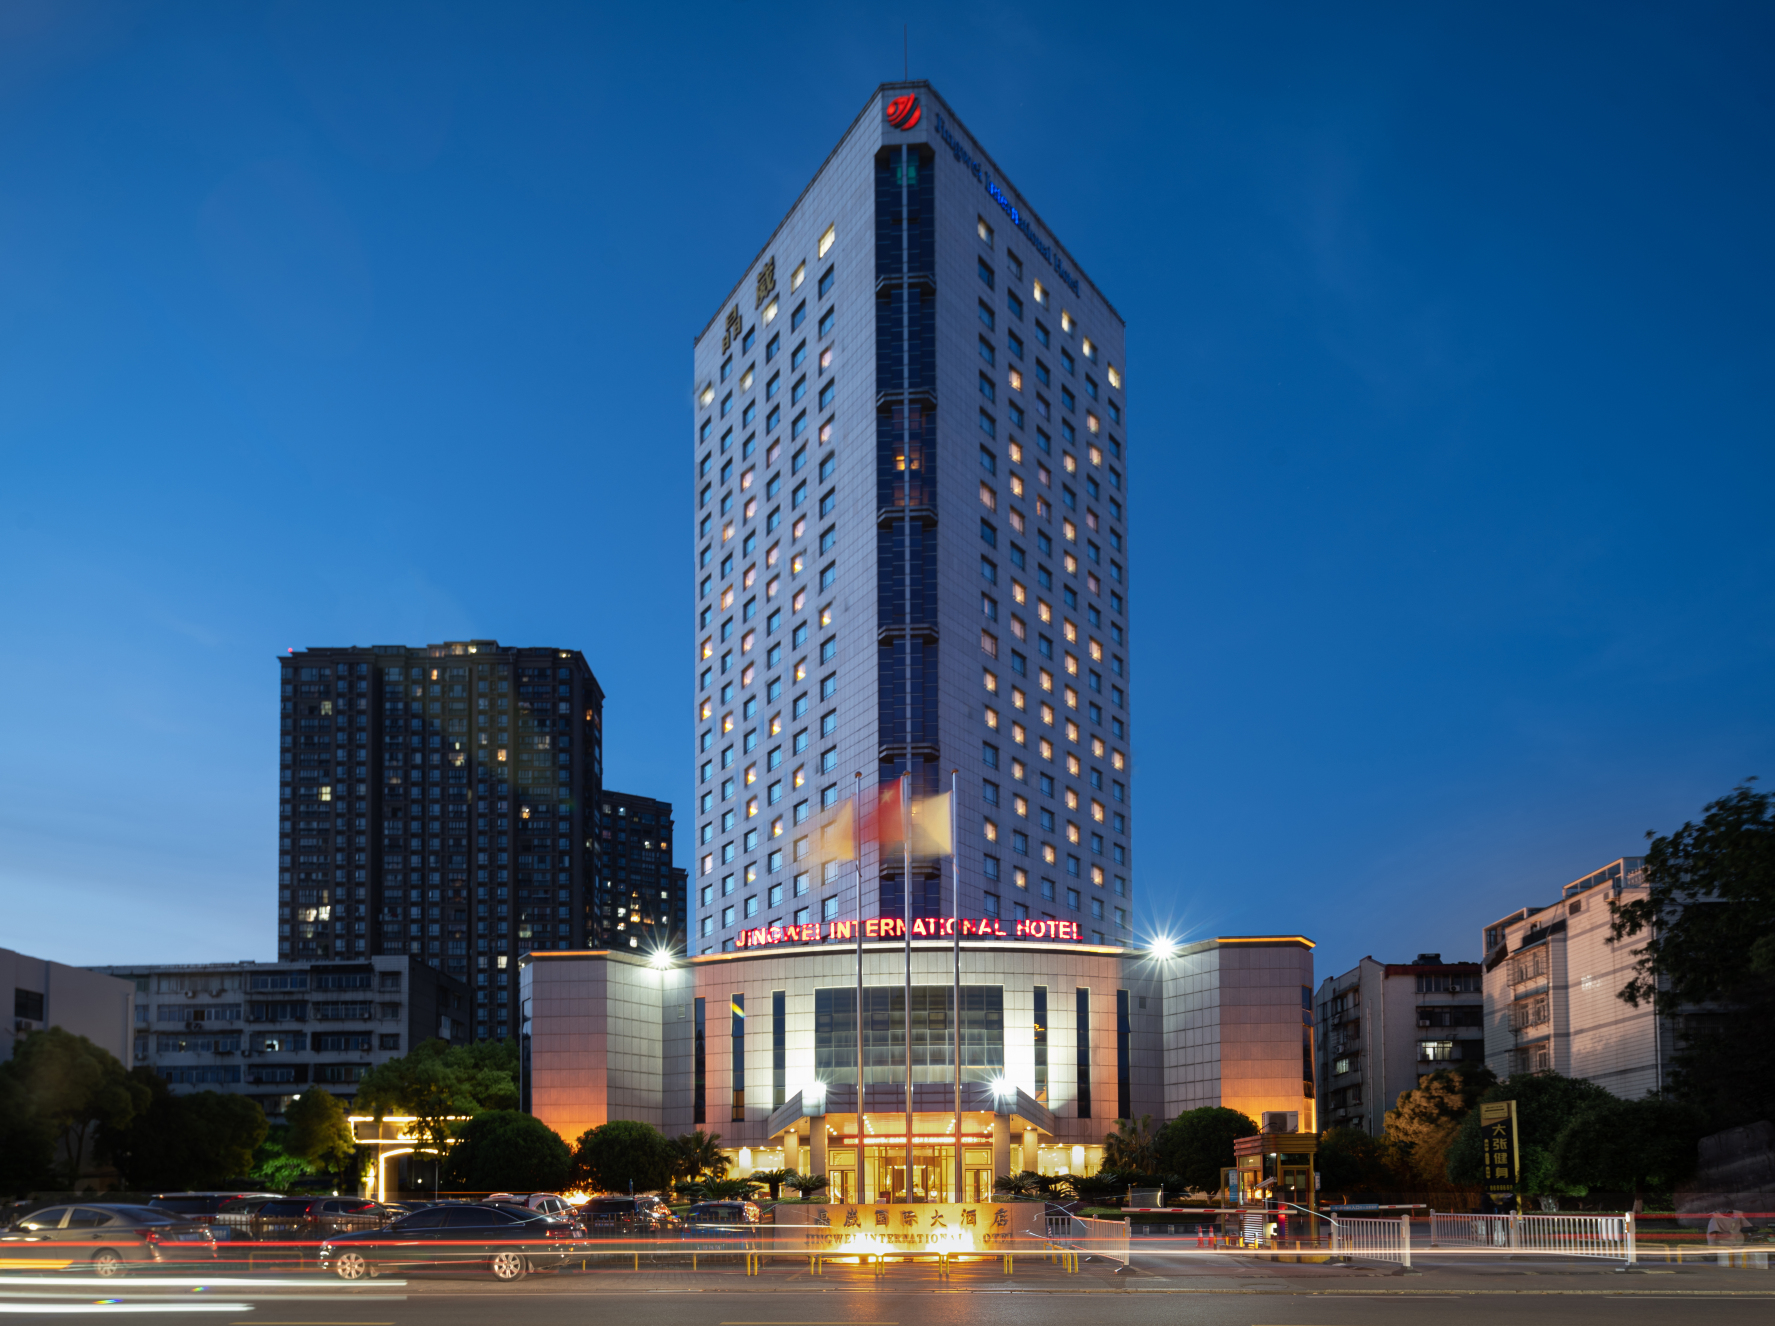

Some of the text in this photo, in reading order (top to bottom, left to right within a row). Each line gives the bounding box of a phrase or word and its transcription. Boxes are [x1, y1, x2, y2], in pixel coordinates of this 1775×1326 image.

[934, 112, 1081, 298] Jingwei International Hotel
[735, 917, 1083, 948] JINGWEI INTERNATIONAL HOTEL
[1491, 1123, 1509, 1179] 大张健身
[804, 1233, 1016, 1246] JINGWEI INTERNATION OTEL
